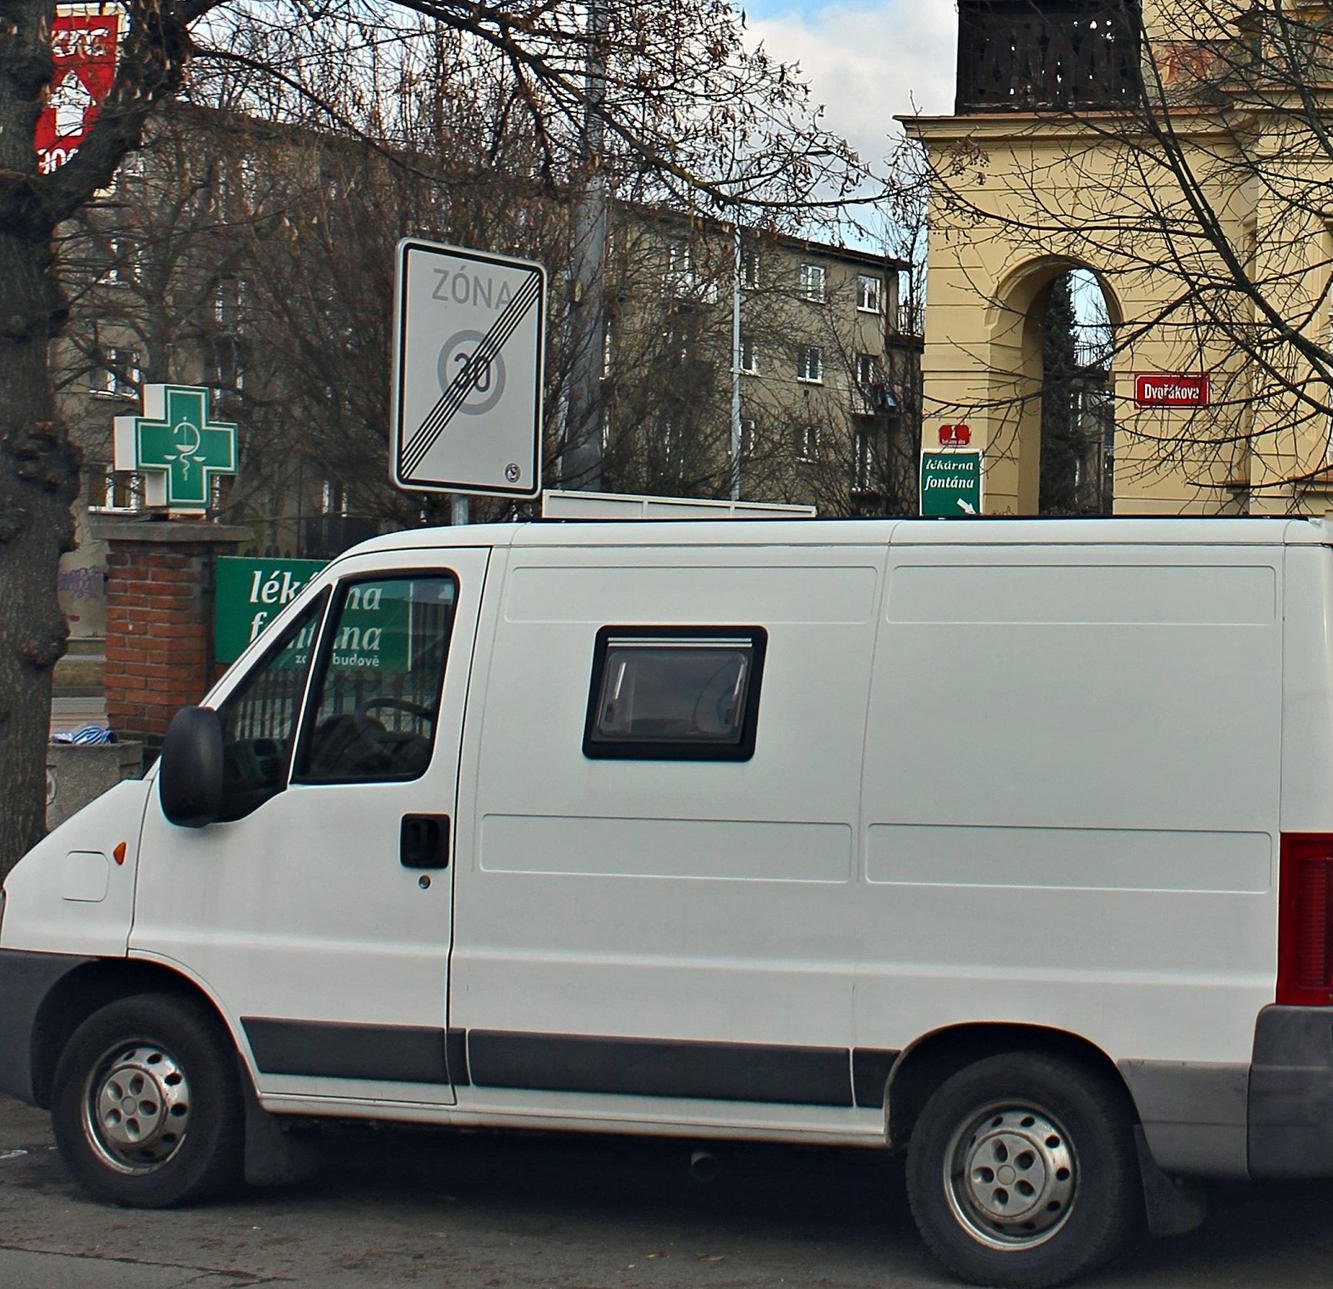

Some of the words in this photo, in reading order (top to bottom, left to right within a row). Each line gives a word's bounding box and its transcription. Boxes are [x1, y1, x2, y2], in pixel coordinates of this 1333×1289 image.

[432, 265, 513, 310] ZÓNA
[1144, 383, 1200, 400] Dvořákova
[926, 460, 974, 470] lékárna
[924, 475, 975, 491] fontána
